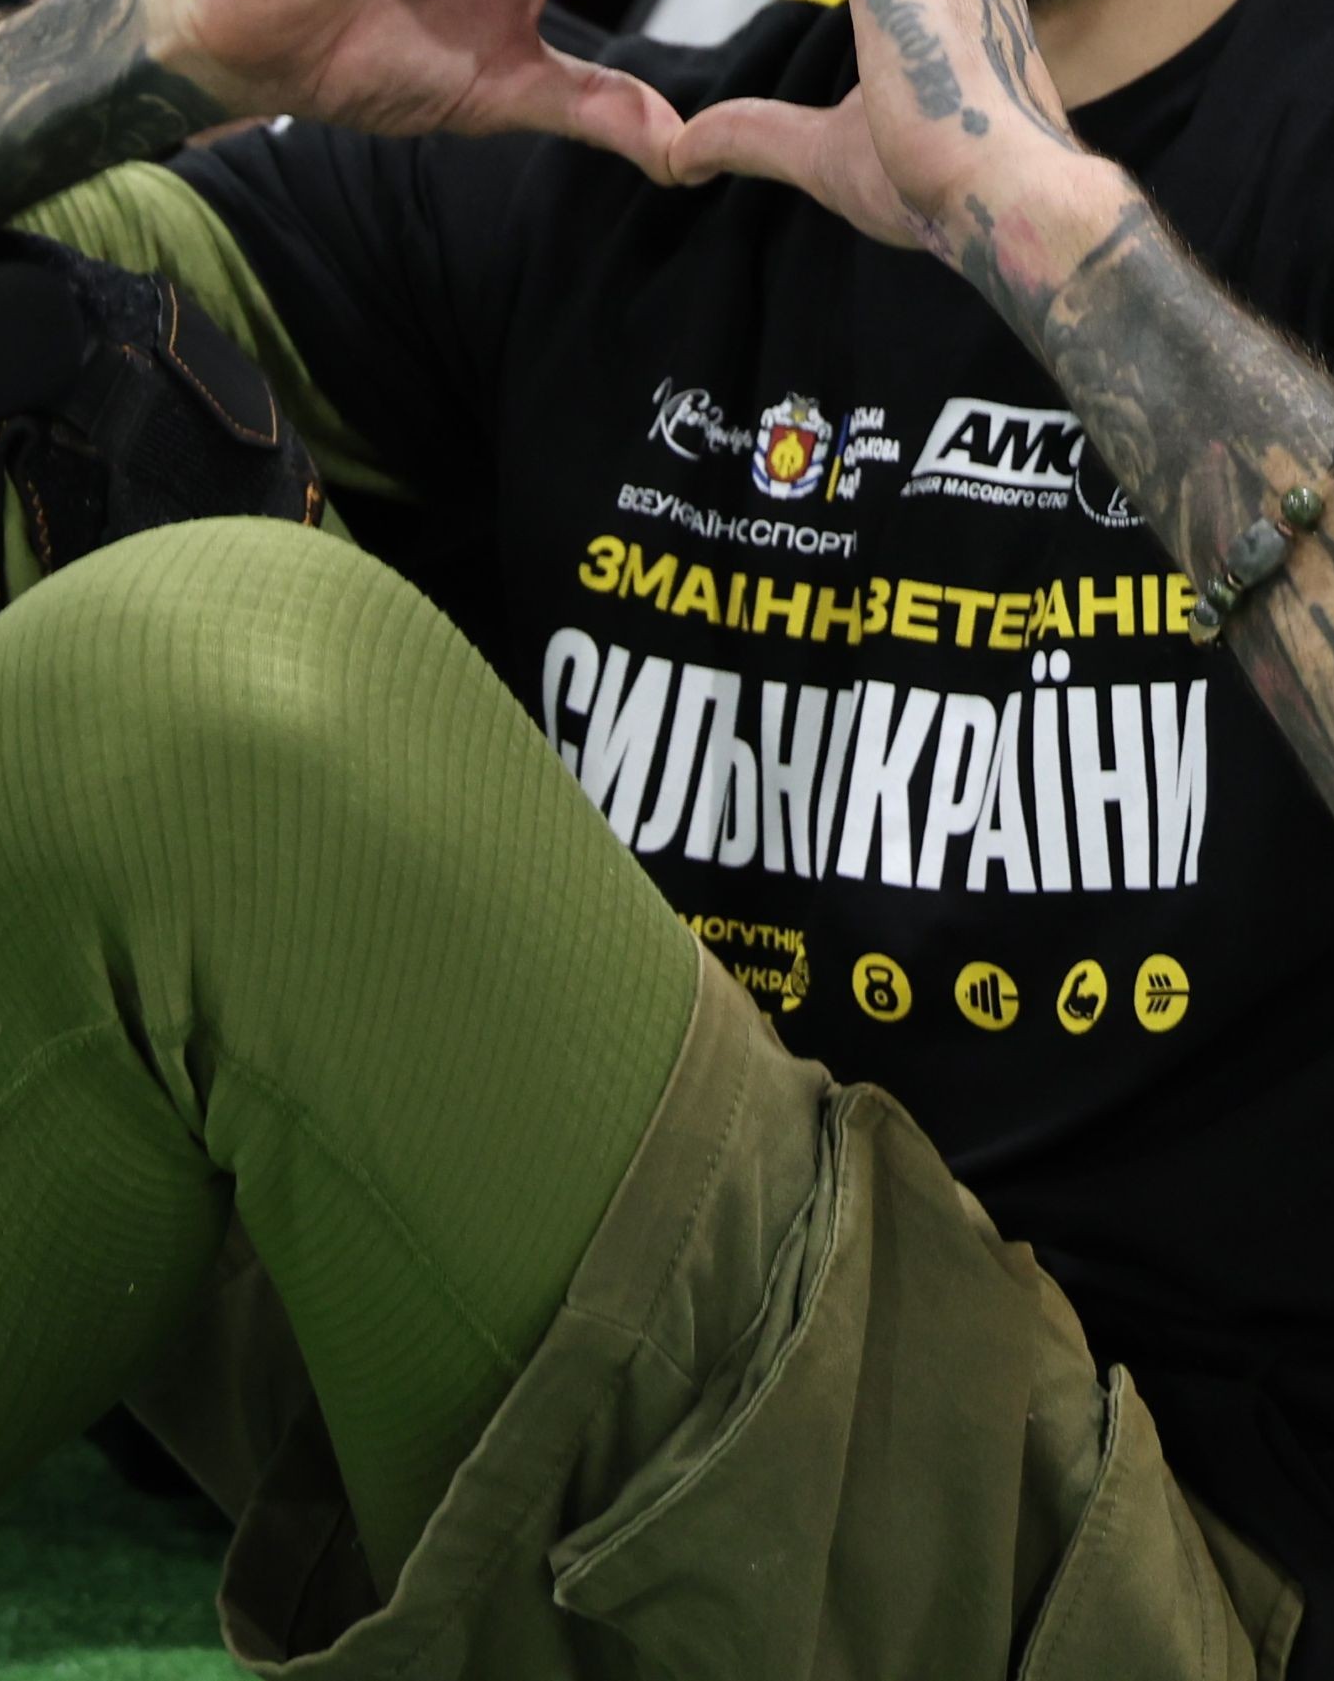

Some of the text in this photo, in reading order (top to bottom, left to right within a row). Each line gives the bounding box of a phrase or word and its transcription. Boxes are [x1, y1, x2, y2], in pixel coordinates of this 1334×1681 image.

[943, 478, 1035, 509] МАСОВОГО
[542, 627, 1208, 893] СИЛЬНІ КРАЇНИ
